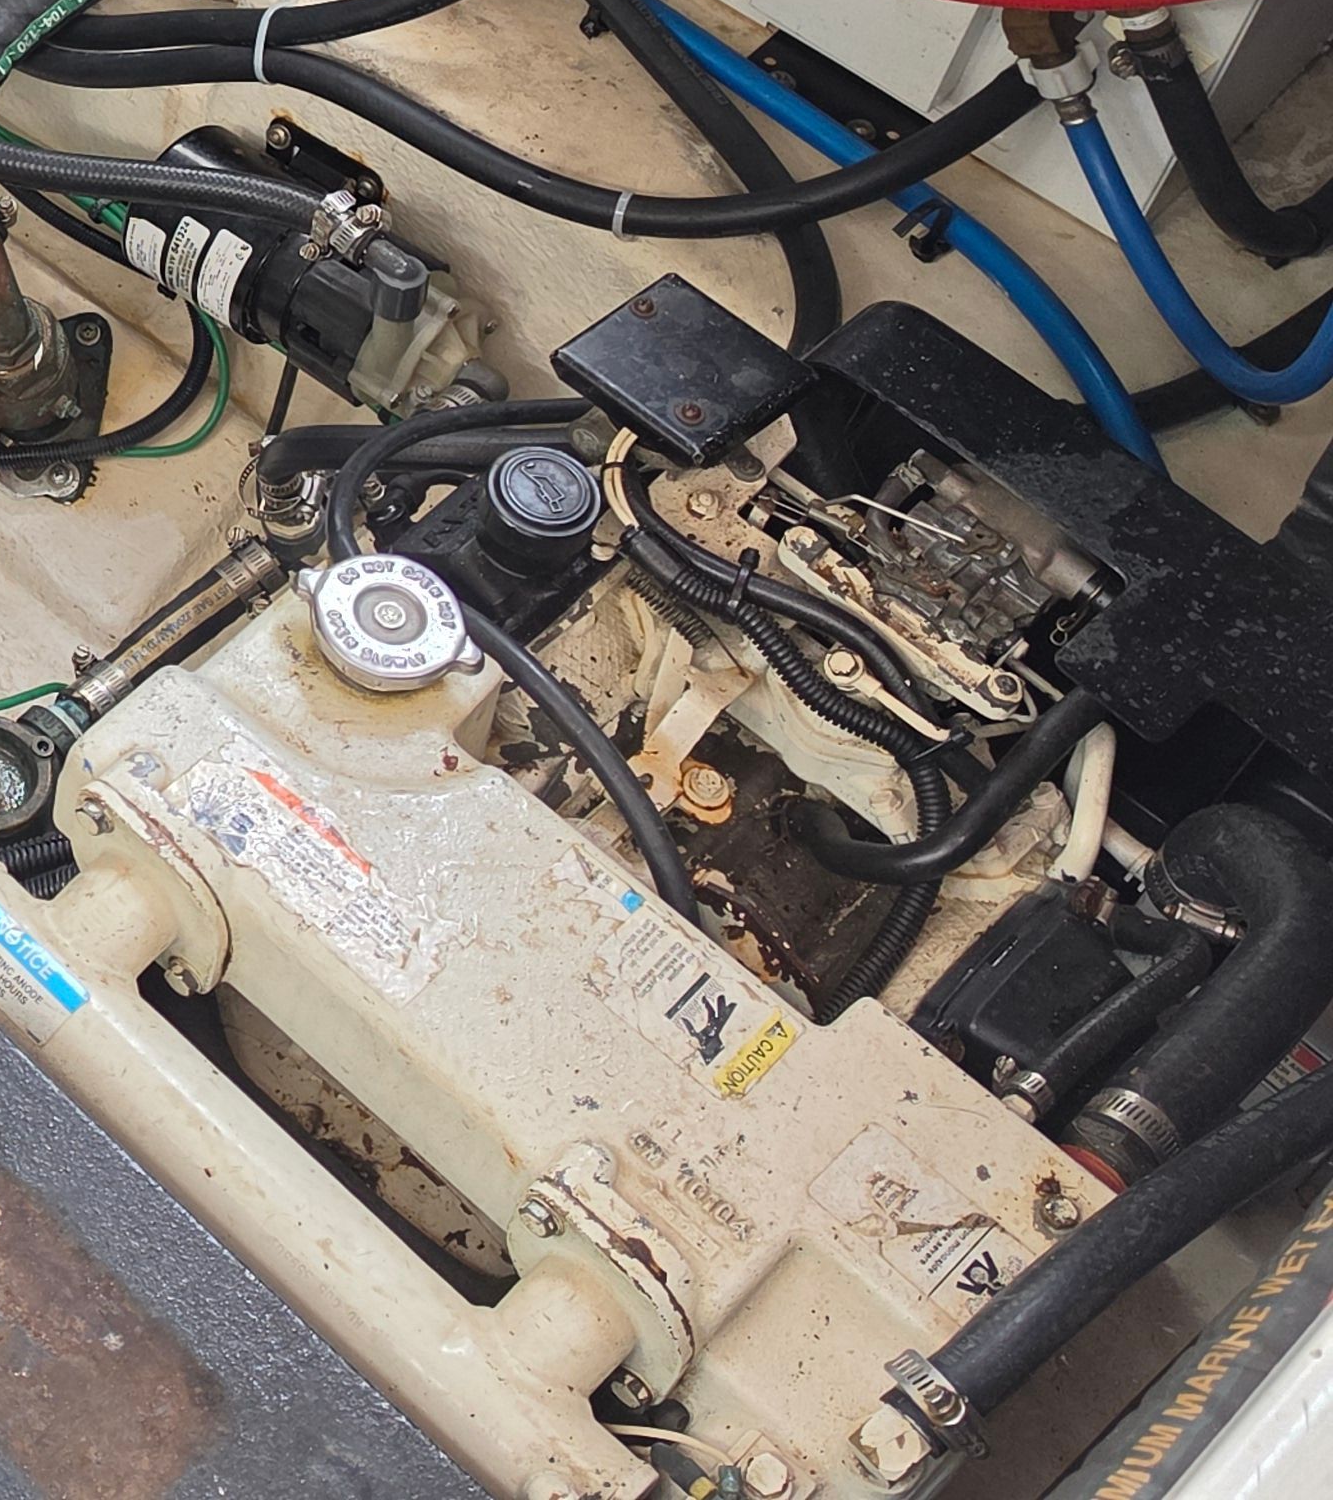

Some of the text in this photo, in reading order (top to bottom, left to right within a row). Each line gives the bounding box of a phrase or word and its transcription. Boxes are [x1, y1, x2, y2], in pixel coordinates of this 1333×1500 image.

[170, 219, 191, 254] 541324
[361, 560, 394, 574] NOT
[401, 565, 443, 599] OPEN
[326, 608, 359, 650] OPEN
[8, 973, 46, 1007] ANODE
[721, 1033, 779, 1098] CAUTION
[1163, 1305, 1271, 1423] MARINE
[1250, 1238, 1319, 1300] WET
